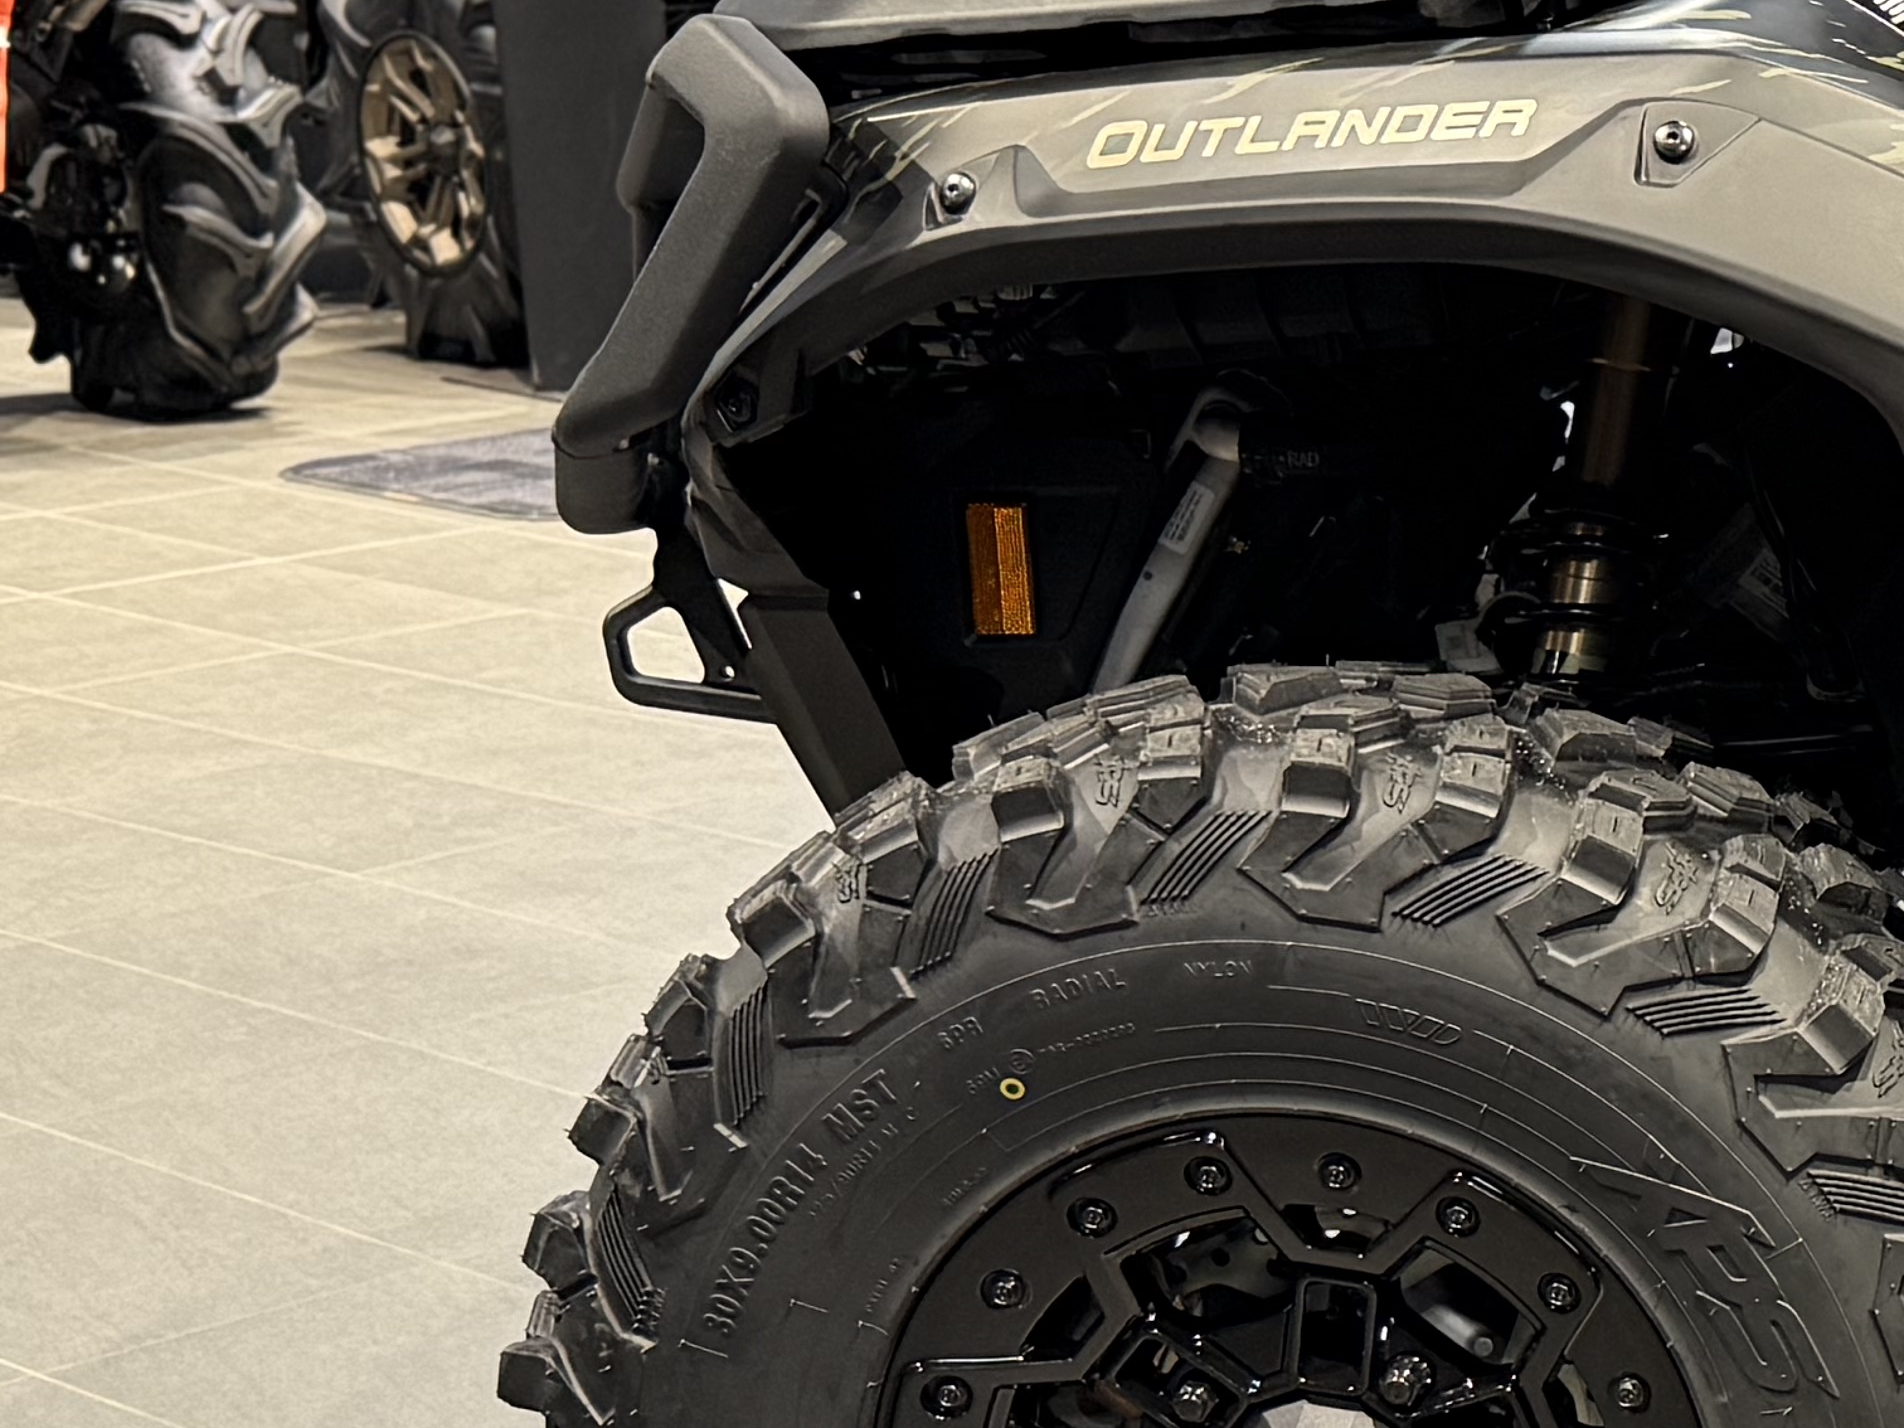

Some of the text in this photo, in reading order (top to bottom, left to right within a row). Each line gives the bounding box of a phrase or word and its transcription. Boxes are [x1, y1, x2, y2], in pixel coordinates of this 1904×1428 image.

[1086, 98, 1538, 169] OUTLANDER
[1028, 967, 1128, 1011] RADIAL
[1183, 957, 1253, 980] NYLON
[822, 1068, 900, 1145] MST
[1569, 1154, 1842, 1400] XPS
